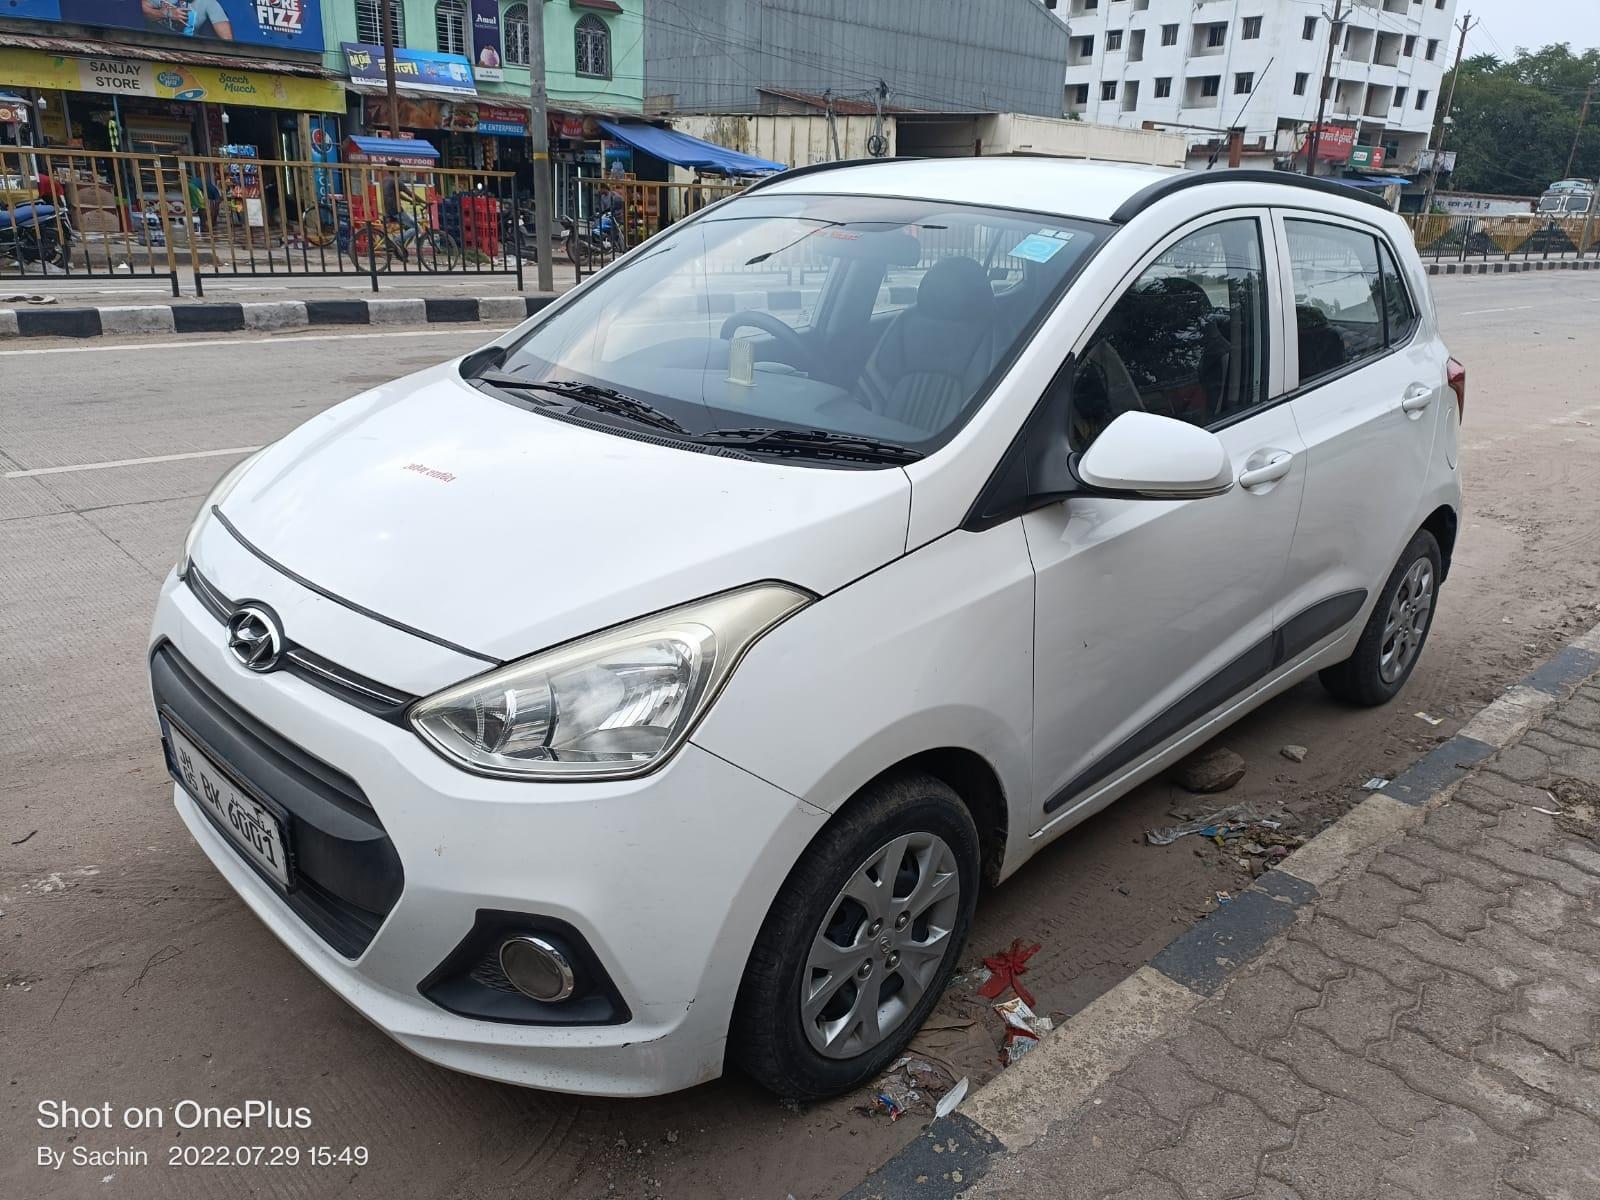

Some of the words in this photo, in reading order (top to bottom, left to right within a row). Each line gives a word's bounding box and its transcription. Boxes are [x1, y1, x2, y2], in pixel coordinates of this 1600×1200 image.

[257, 6, 302, 29] FIZZ
[475, 13, 497, 25] Amul
[89, 60, 142, 77] SANJAY
[95, 76, 141, 90] STORE
[487, 123, 525, 134] ENTERPRISES
[180, 747, 194, 773] JH
[200, 773, 226, 817] BK
[228, 804, 278, 869] 6001
